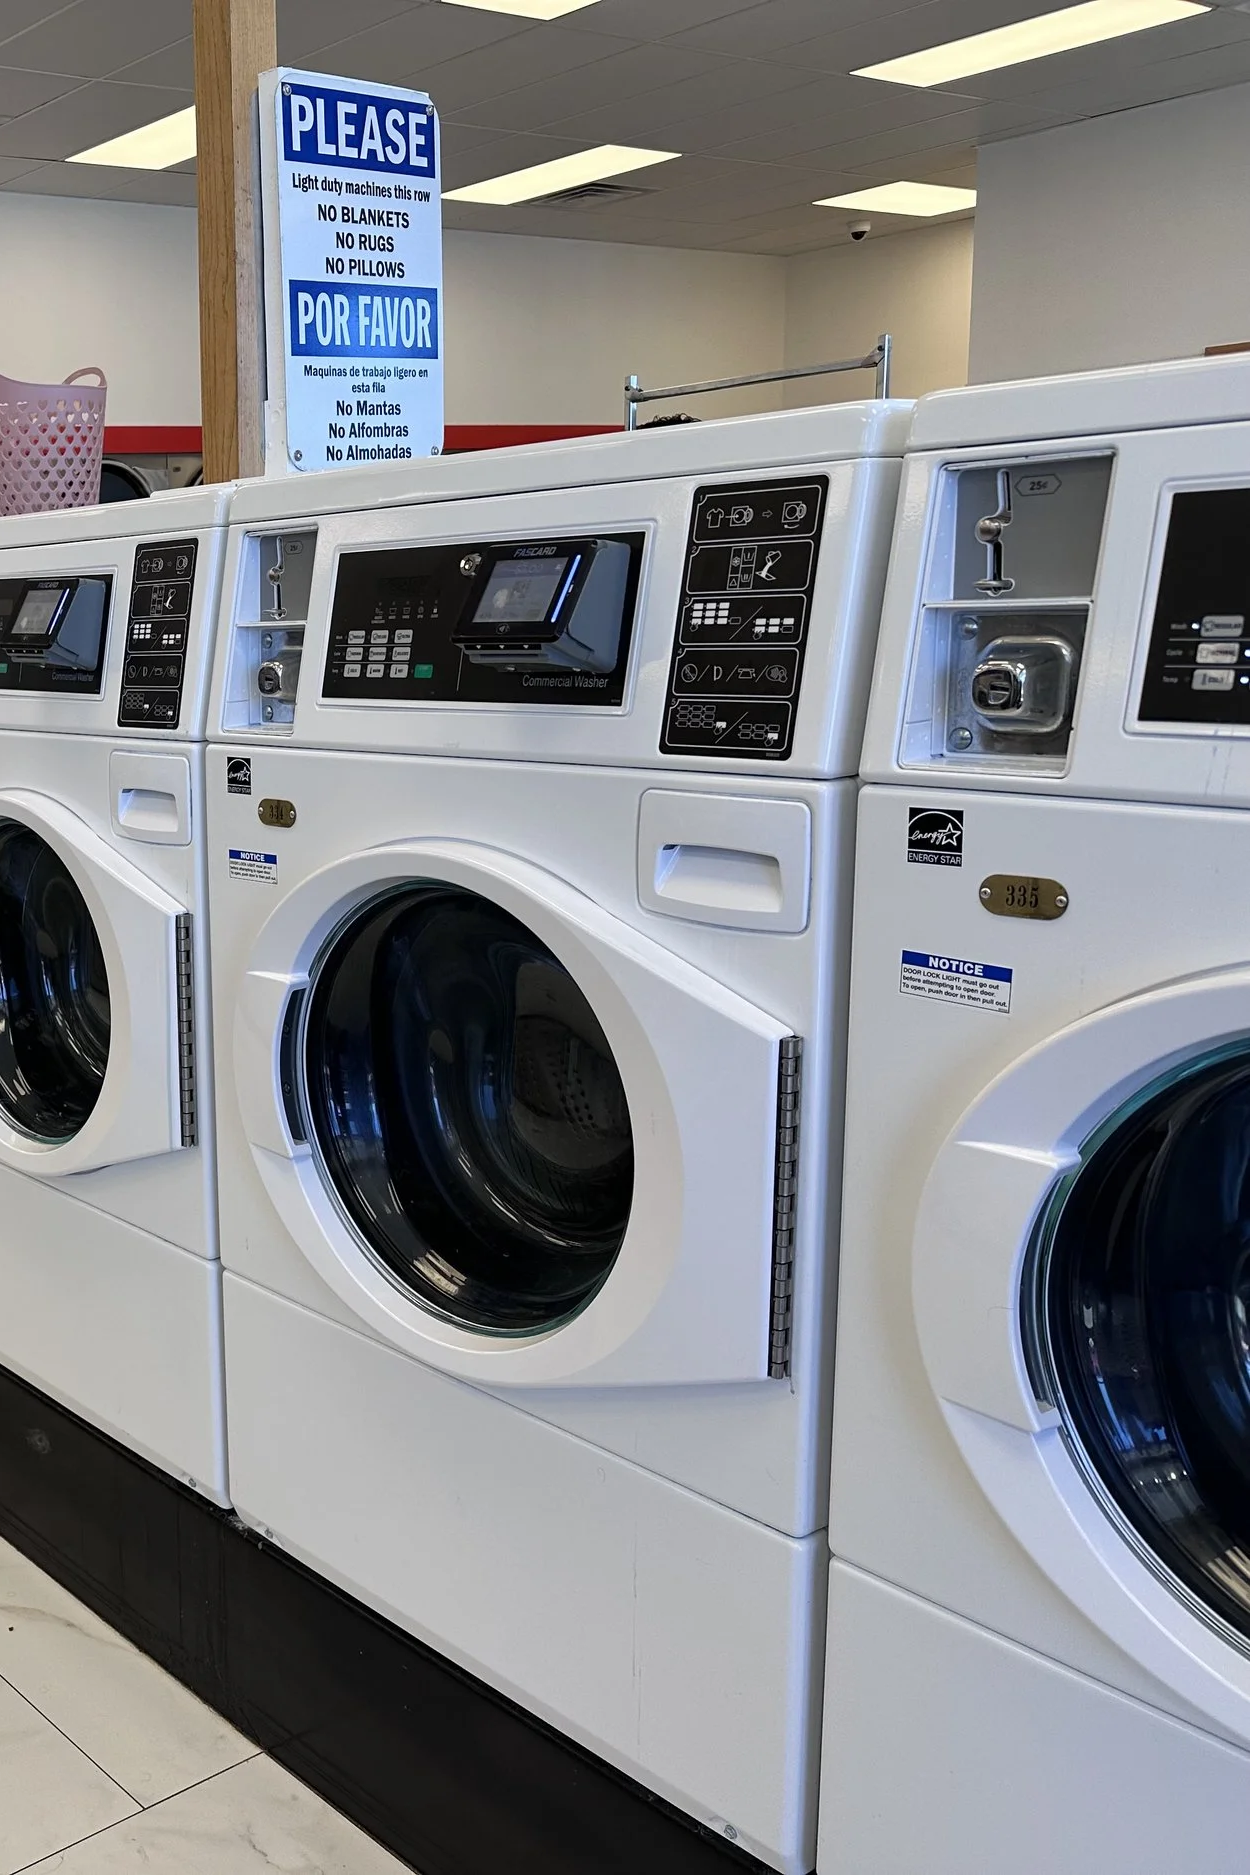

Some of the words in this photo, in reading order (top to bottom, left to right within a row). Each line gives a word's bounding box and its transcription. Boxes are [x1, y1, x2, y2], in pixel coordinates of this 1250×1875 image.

[290, 94, 428, 167] PLEASE
[292, 173, 318, 192] Light
[321, 177, 342, 196] duty
[345, 181, 392, 198] machines
[394, 185, 412, 200] this
[414, 190, 430, 202] row
[318, 204, 336, 222] NO
[342, 206, 409, 228] BLANKETS
[336, 232, 354, 249] NO
[359, 234, 394, 252] RUGS
[326, 257, 344, 274] NO
[349, 258, 405, 278] PILLOWS
[298, 292, 350, 346] POR
[359, 295, 432, 348] FAVOR
[304, 365, 347, 379] Maquinas
[350, 366, 359, 376] de
[362, 367, 391, 379] trabajo
[394, 367, 416, 379] ligero
[418, 369, 428, 377] en
[352, 383, 370, 392] esta
[372, 382, 385, 392] fila
[336, 401, 352, 416] No
[357, 401, 401, 415] Mantas
[329, 423, 345, 438] No
[349, 422, 408, 438] Alfombras
[326, 446, 342, 461] No
[346, 444, 412, 460] Almohadas
[514, 547, 556, 557] FASCARD
[522, 675, 572, 688] Commercial
[575, 675, 608, 688] Washer
[240, 852, 265, 861] NOTICE
[909, 853, 938, 862] ENERGY
[941, 855, 961, 864] STAR
[1006, 885, 1039, 908] 335
[929, 956, 983, 976] NOTICE
[923, 971, 940, 979] LOCK
[942, 975, 961, 983] LIGHT
[903, 975, 921, 983] before
[922, 979, 954, 990] attempting
[980, 989, 996, 997] door.
